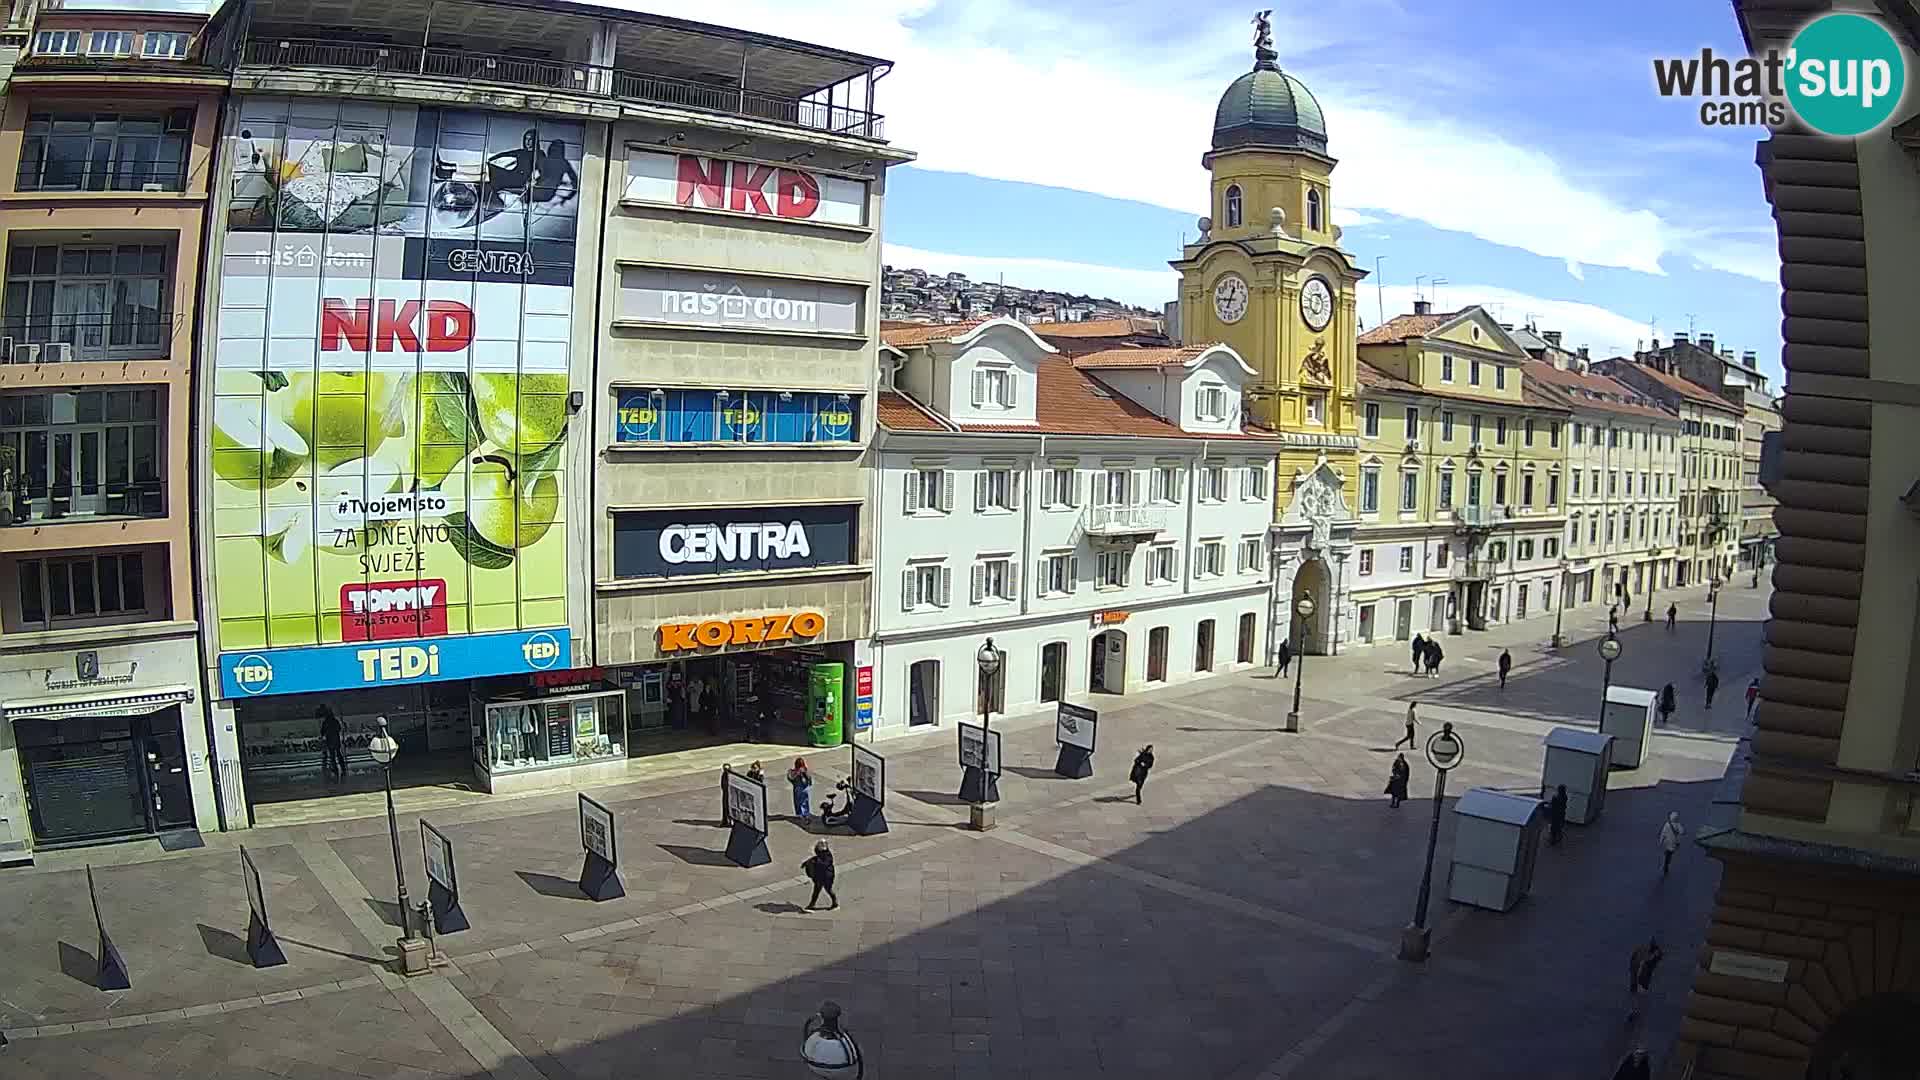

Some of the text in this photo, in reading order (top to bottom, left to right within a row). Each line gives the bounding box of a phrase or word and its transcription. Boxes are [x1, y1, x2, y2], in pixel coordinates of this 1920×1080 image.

[676, 153, 821, 218] NKD
[447, 249, 535, 276] CENTRA
[661, 283, 817, 322] naš dom
[320, 297, 476, 353] NKD
[338, 496, 446, 516] #TvojeMisto
[333, 522, 451, 548] ZA DNEVNO
[659, 520, 812, 564] CENTRA
[359, 546, 426, 575] SVJEŽE
[348, 585, 439, 614] TOMMY
[658, 611, 826, 653] KORZO
[357, 645, 440, 682] TEDi
[523, 641, 560, 660] TEDi
[233, 665, 273, 683] TEDi
